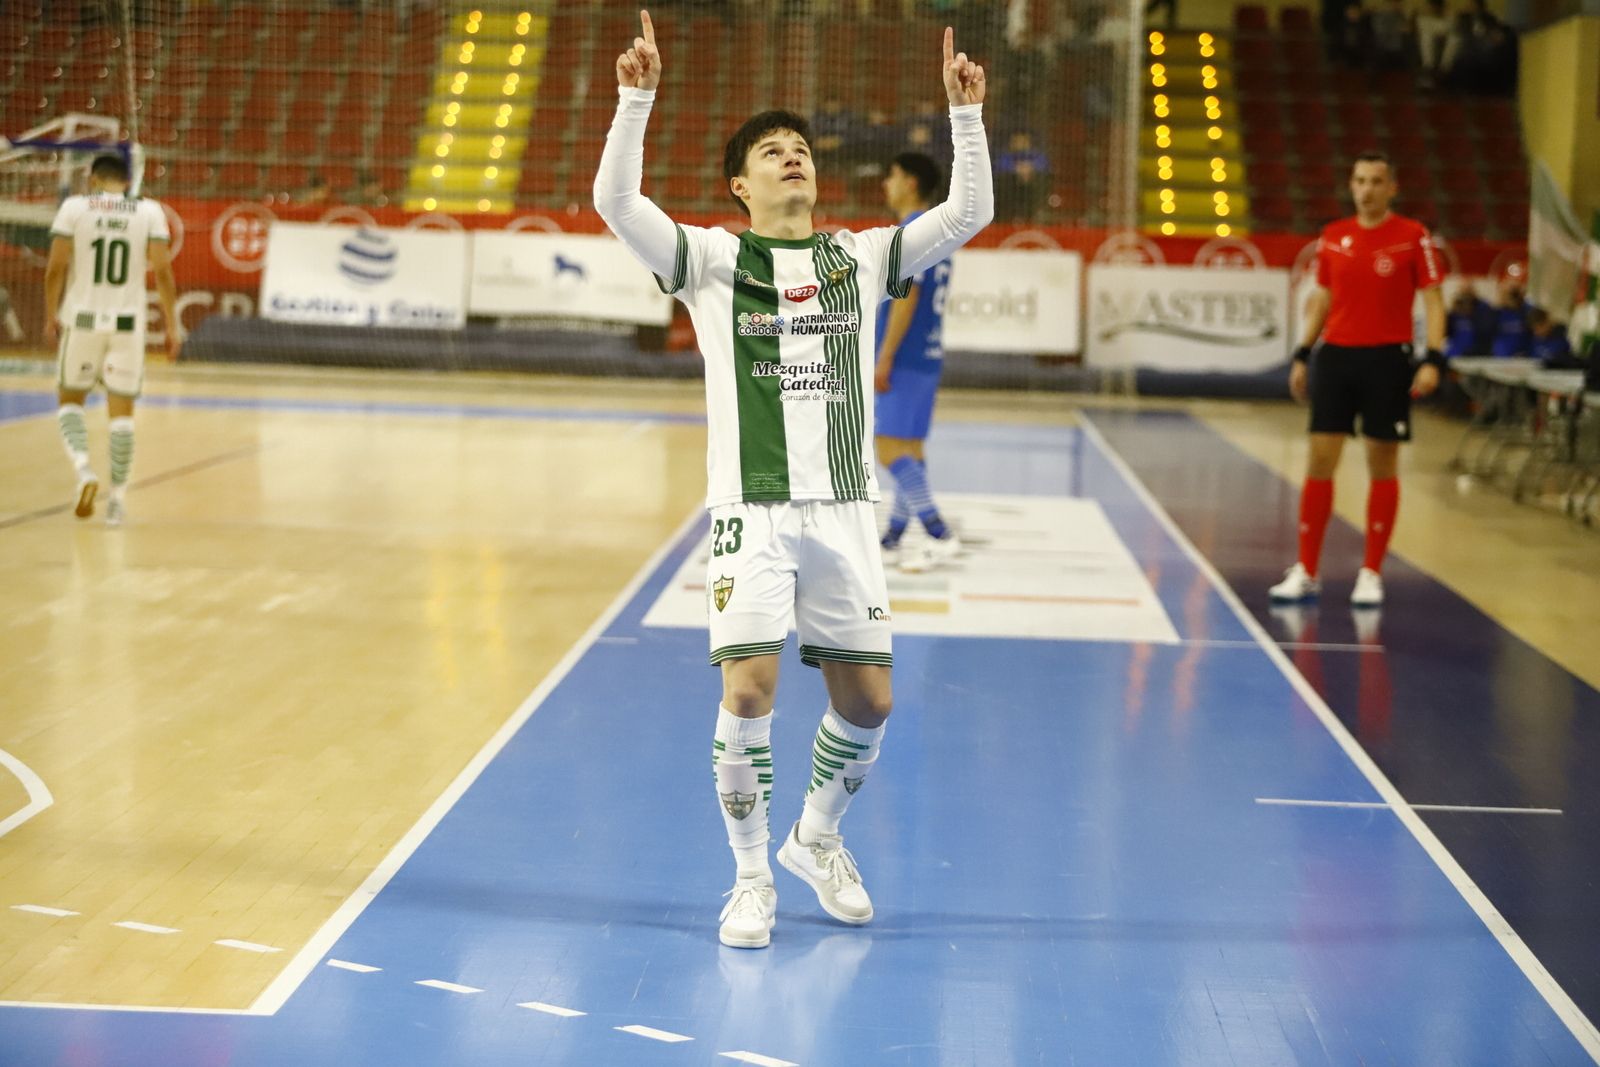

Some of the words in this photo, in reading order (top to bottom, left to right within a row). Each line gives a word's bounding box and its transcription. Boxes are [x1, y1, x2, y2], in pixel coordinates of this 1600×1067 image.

[91, 238, 130, 285] 10
[792, 313, 849, 324] PATRIMONIO
[791, 323, 858, 335] HUMANIDAD
[753, 362, 836, 377] Mezquita-
[780, 377, 845, 390] Catedral
[713, 517, 743, 557] 23
